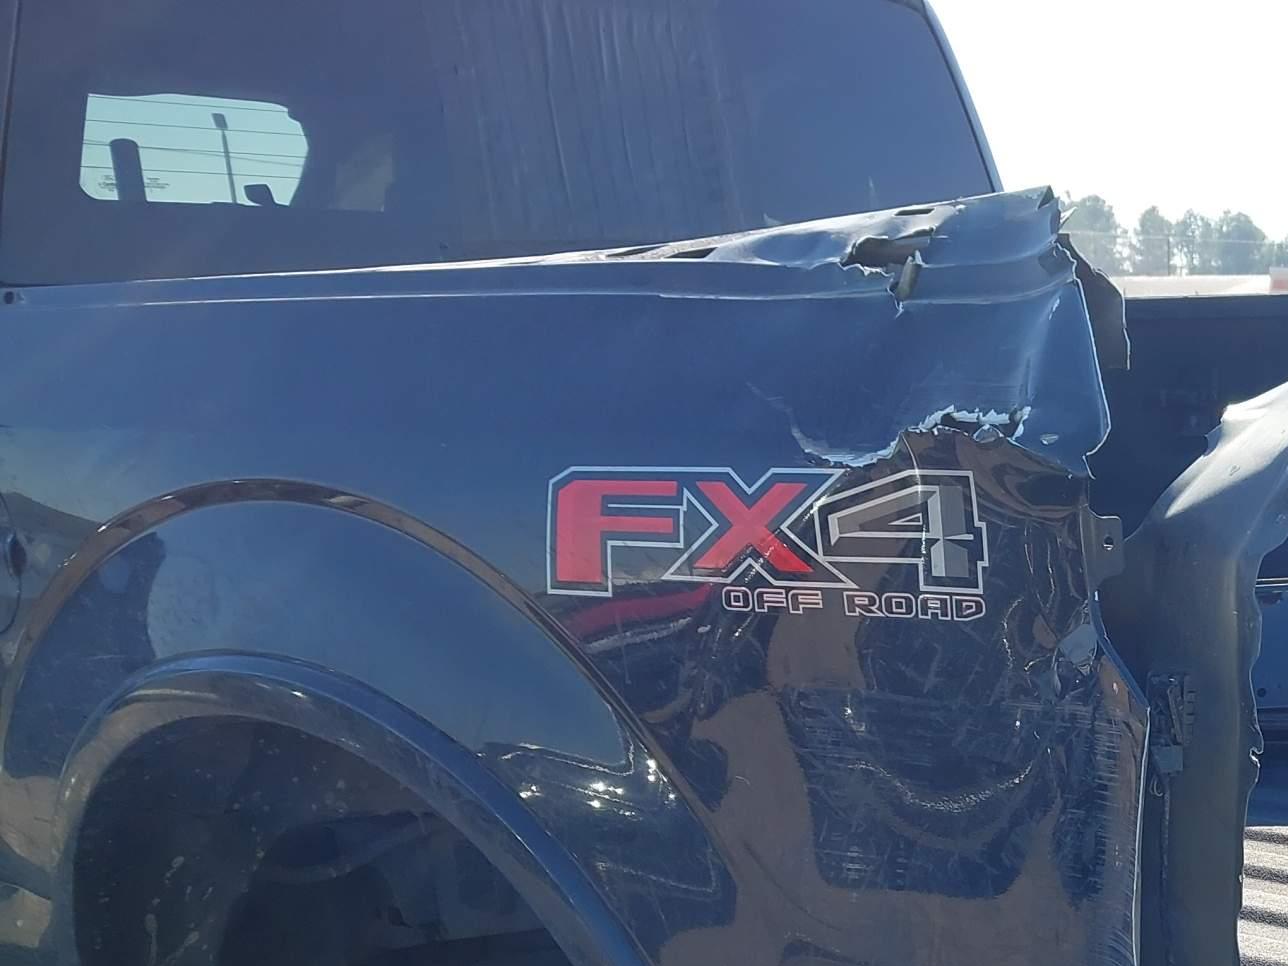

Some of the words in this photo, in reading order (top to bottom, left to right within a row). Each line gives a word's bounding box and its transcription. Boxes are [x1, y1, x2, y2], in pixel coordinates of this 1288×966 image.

[546, 466, 989, 597] FX4
[721, 585, 824, 614] OFF
[843, 590, 986, 621] ROAD
